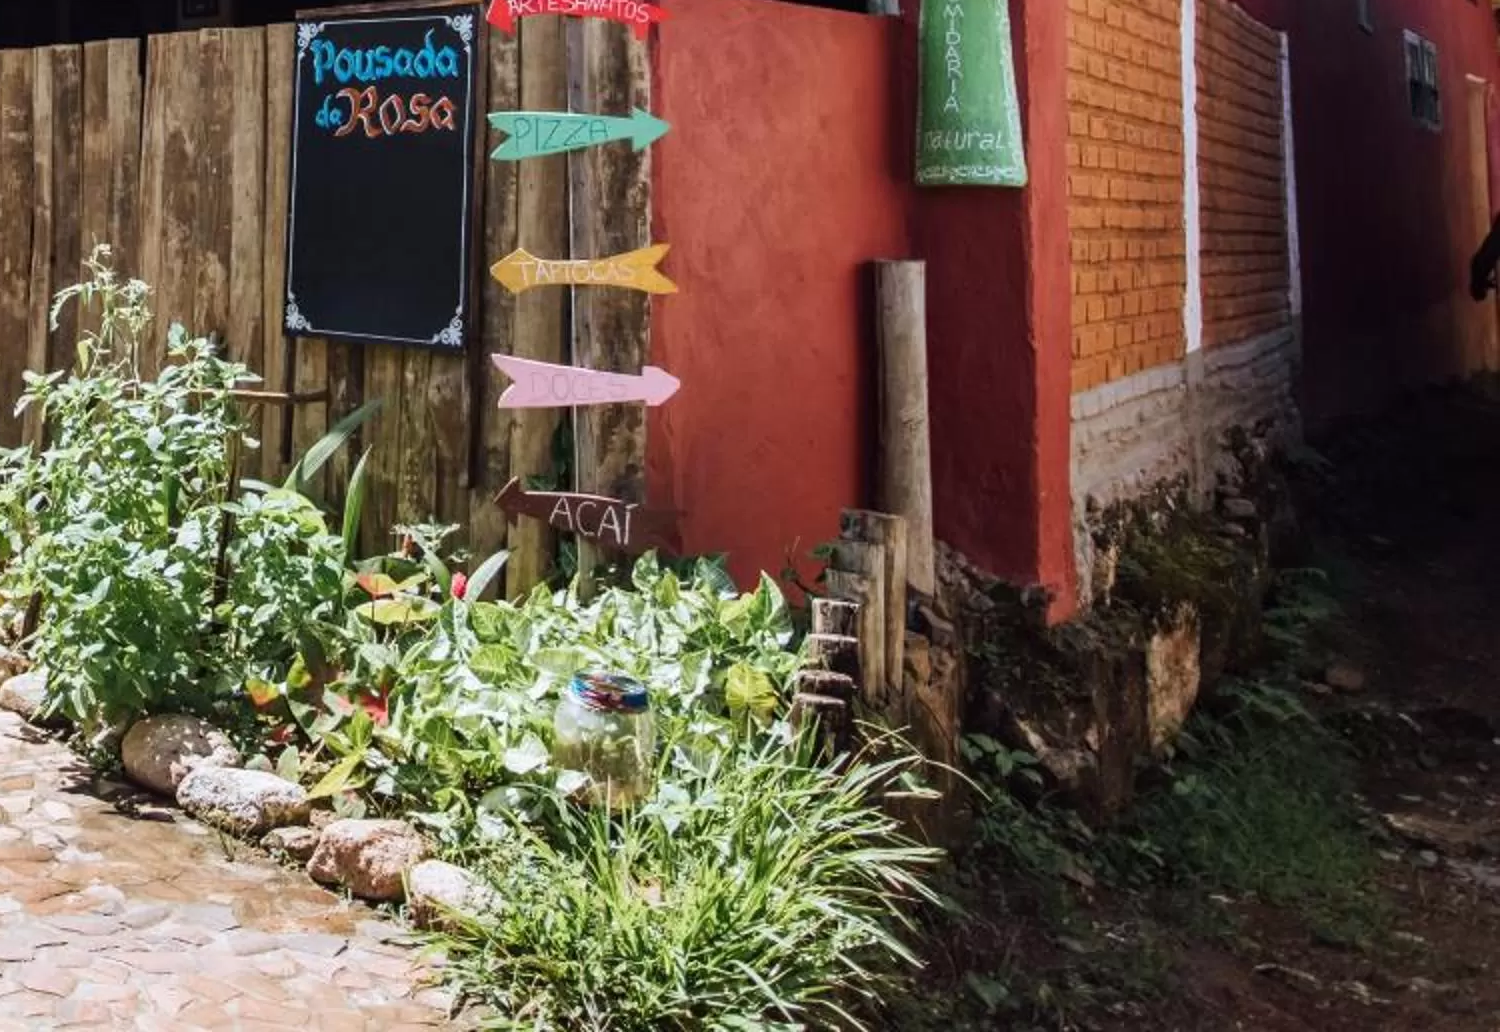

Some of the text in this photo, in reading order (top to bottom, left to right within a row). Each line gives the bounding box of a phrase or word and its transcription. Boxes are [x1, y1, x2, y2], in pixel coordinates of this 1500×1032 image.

[310, 28, 460, 85] Pousada
[332, 84, 457, 138] Rosa
[513, 118, 609, 152] PIZZA
[511, 261, 636, 282] TAPIOCAS
